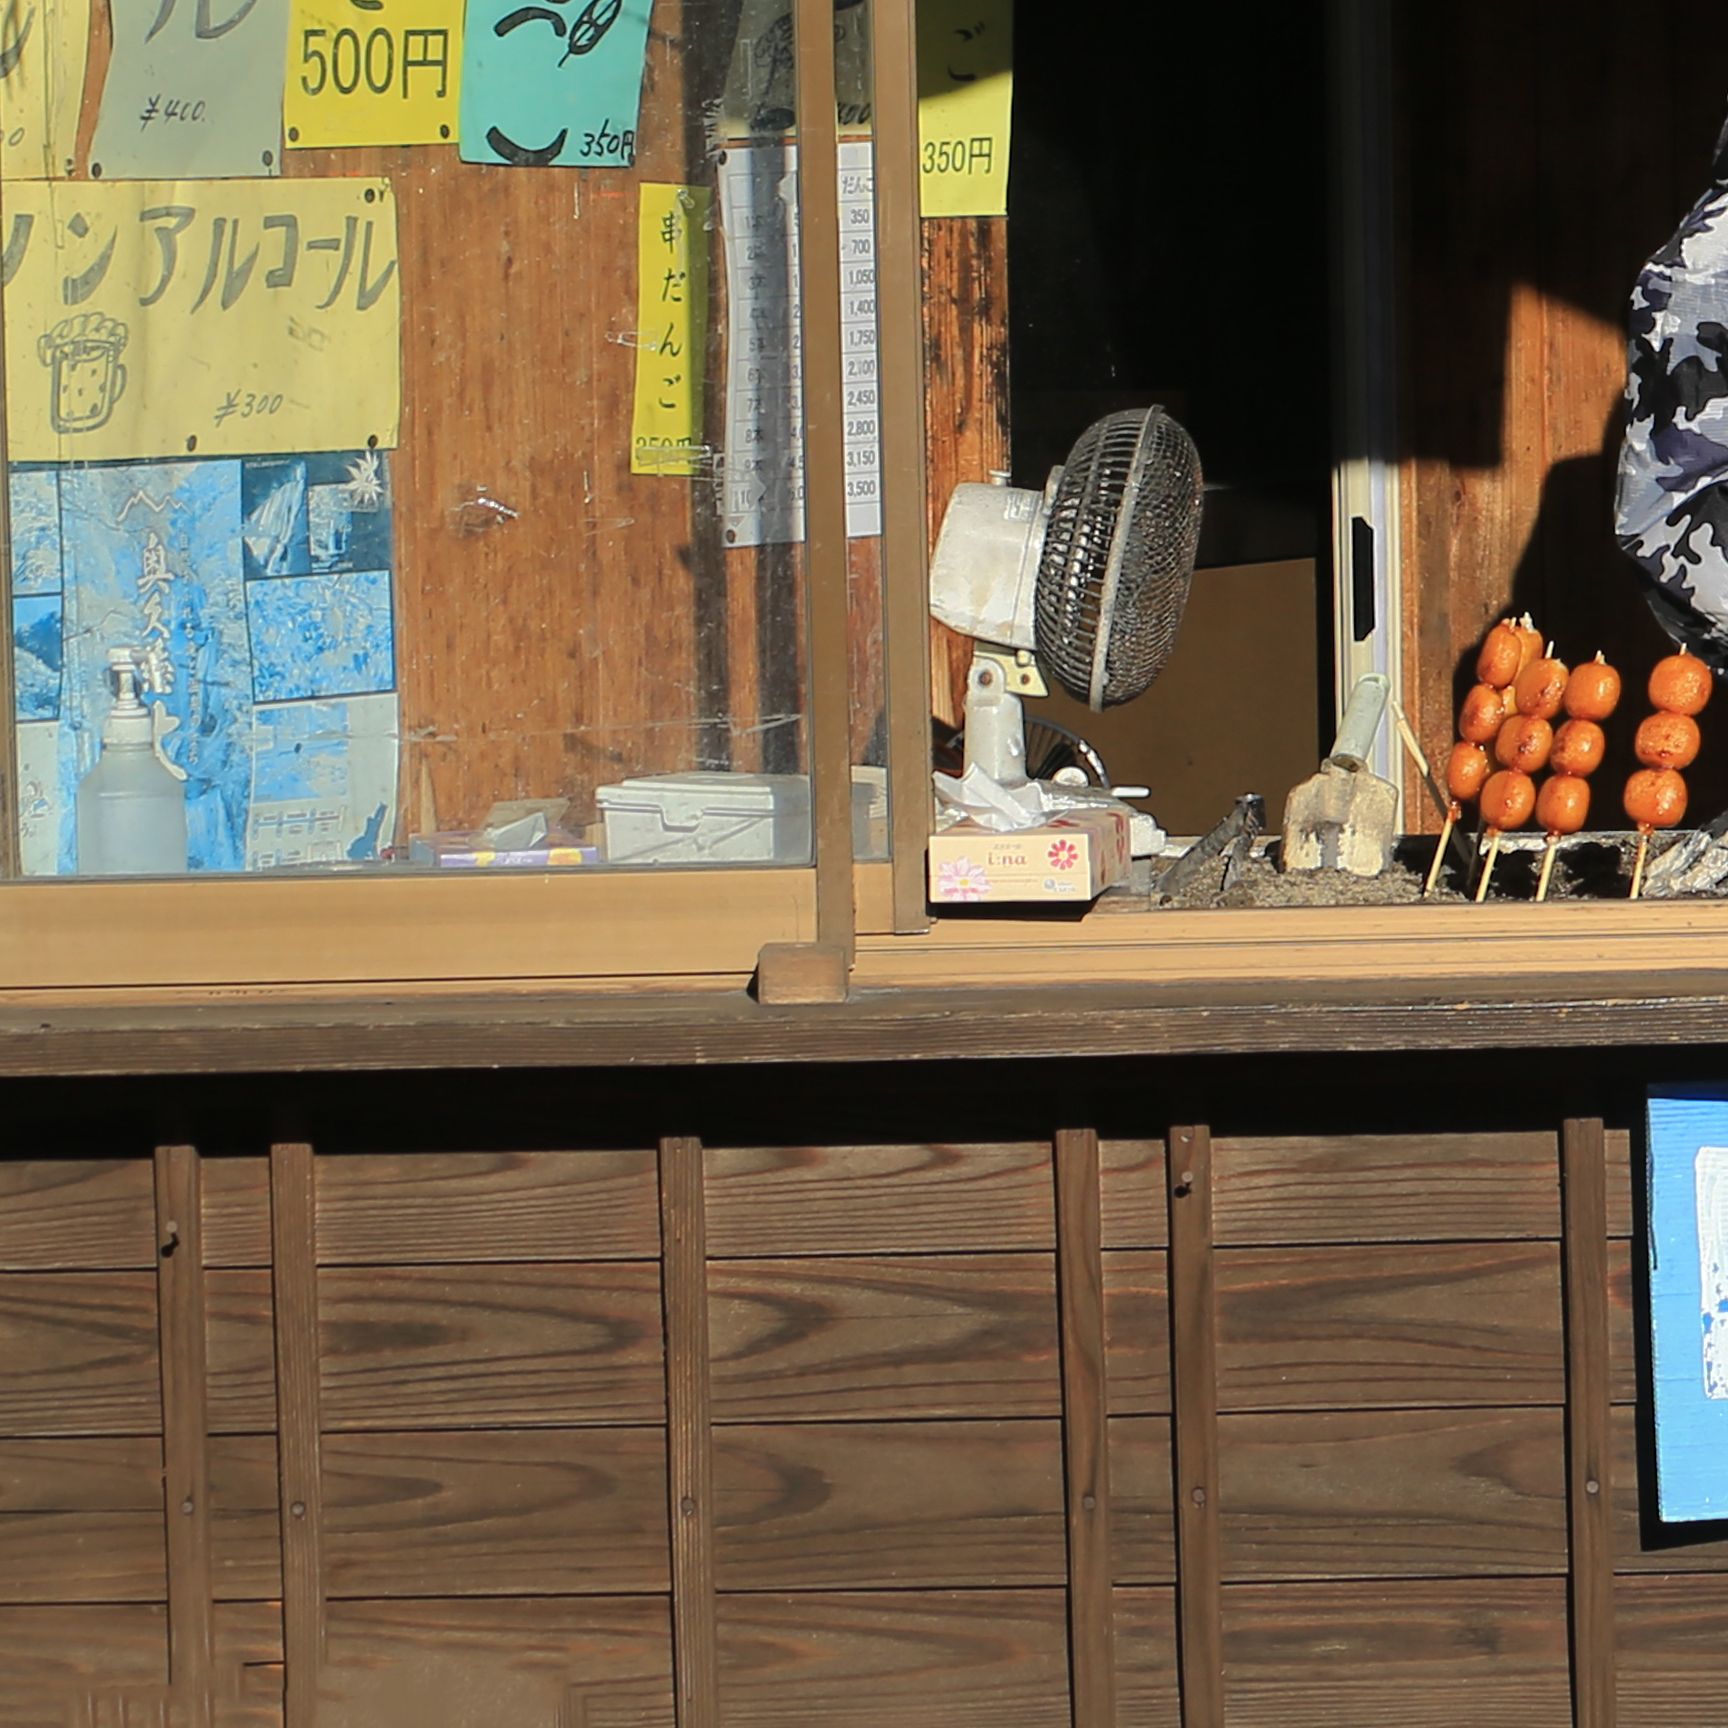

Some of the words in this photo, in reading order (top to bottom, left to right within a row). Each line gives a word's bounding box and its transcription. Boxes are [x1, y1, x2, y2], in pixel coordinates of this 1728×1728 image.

[301, 28, 448, 98] 500円
[580, 119, 635, 163] 350円
[922, 138, 993, 177] 350円
[850, 209, 870, 224] 350
[851, 239, 871, 255] 700
[0, 213, 397, 314] ノンアルコール
[658, 210, 687, 411] 串だんご
[849, 300, 875, 316] 1,400
[849, 329, 876, 346] 1,750
[847, 389, 876, 407] 2,450
[847, 420, 876, 437] 2,800
[846, 450, 876, 467] 3,150
[846, 480, 877, 497] 3,500
